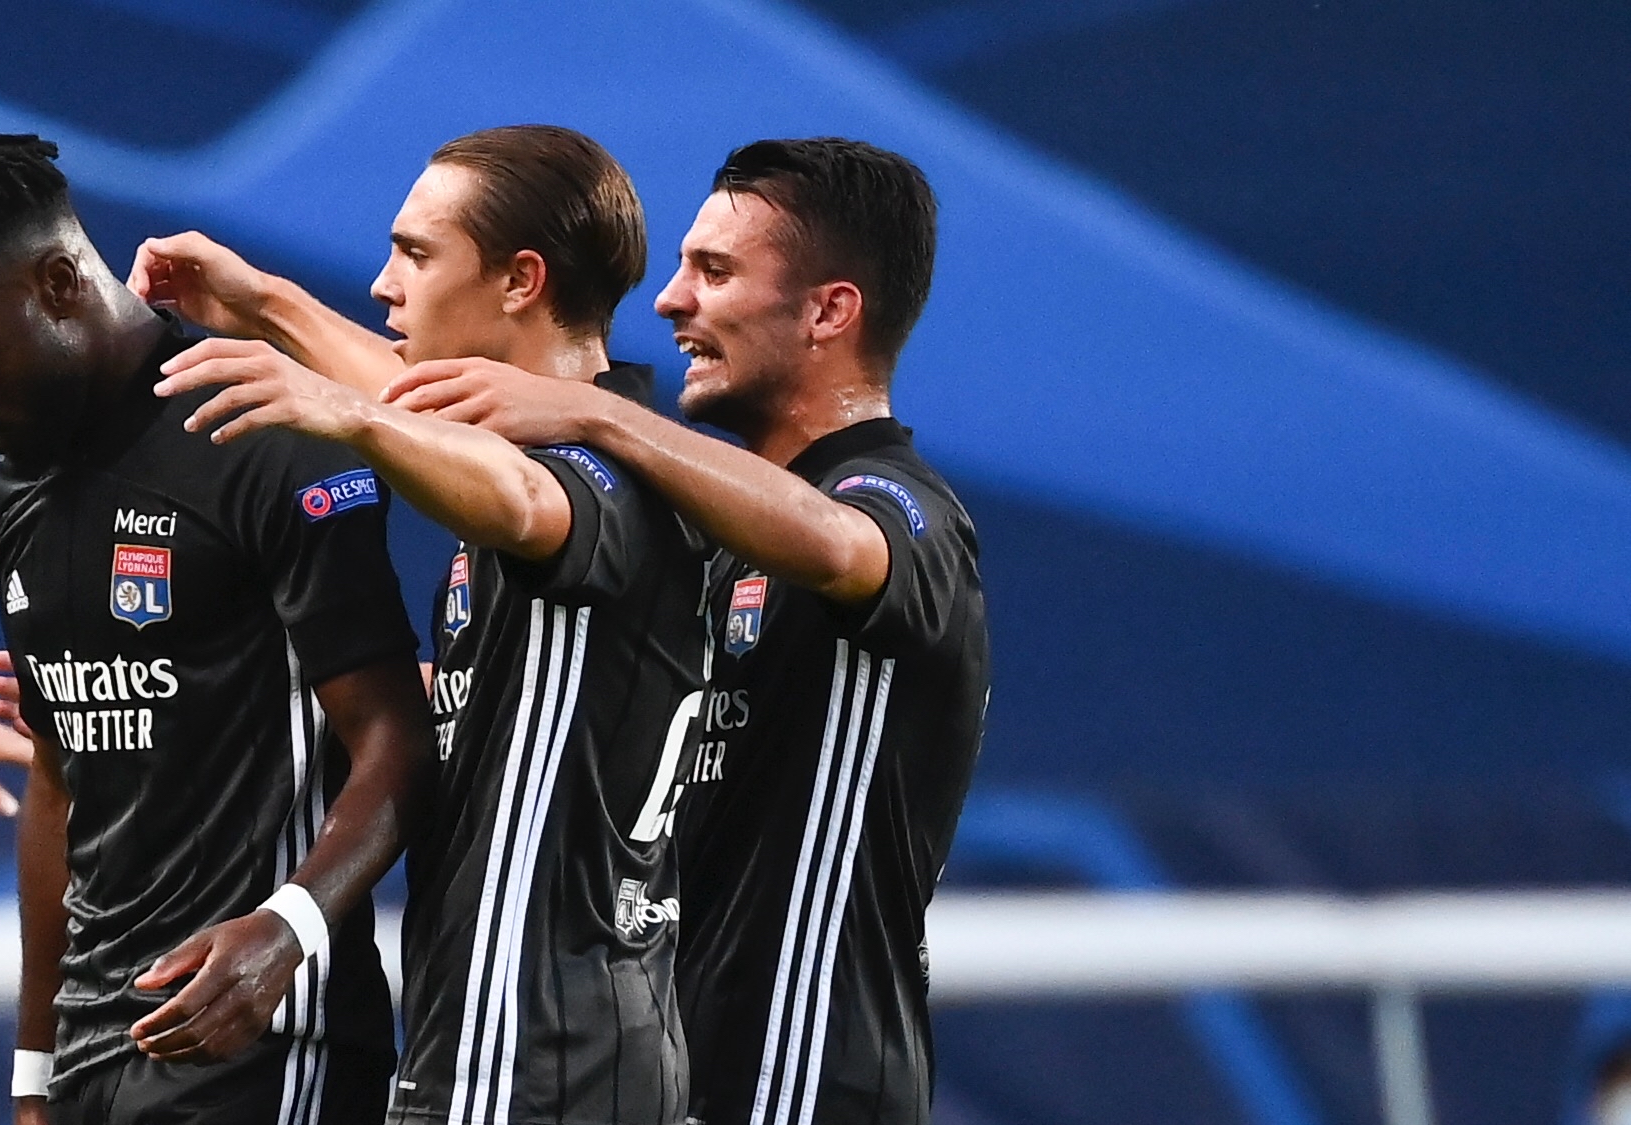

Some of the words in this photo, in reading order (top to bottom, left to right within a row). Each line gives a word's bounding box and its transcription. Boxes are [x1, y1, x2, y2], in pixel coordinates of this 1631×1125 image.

[113, 507, 178, 537] Merci
[117, 560, 165, 575] LYONNAIS
[24, 649, 179, 702] Emirates
[72, 708, 153, 753] BETTER
